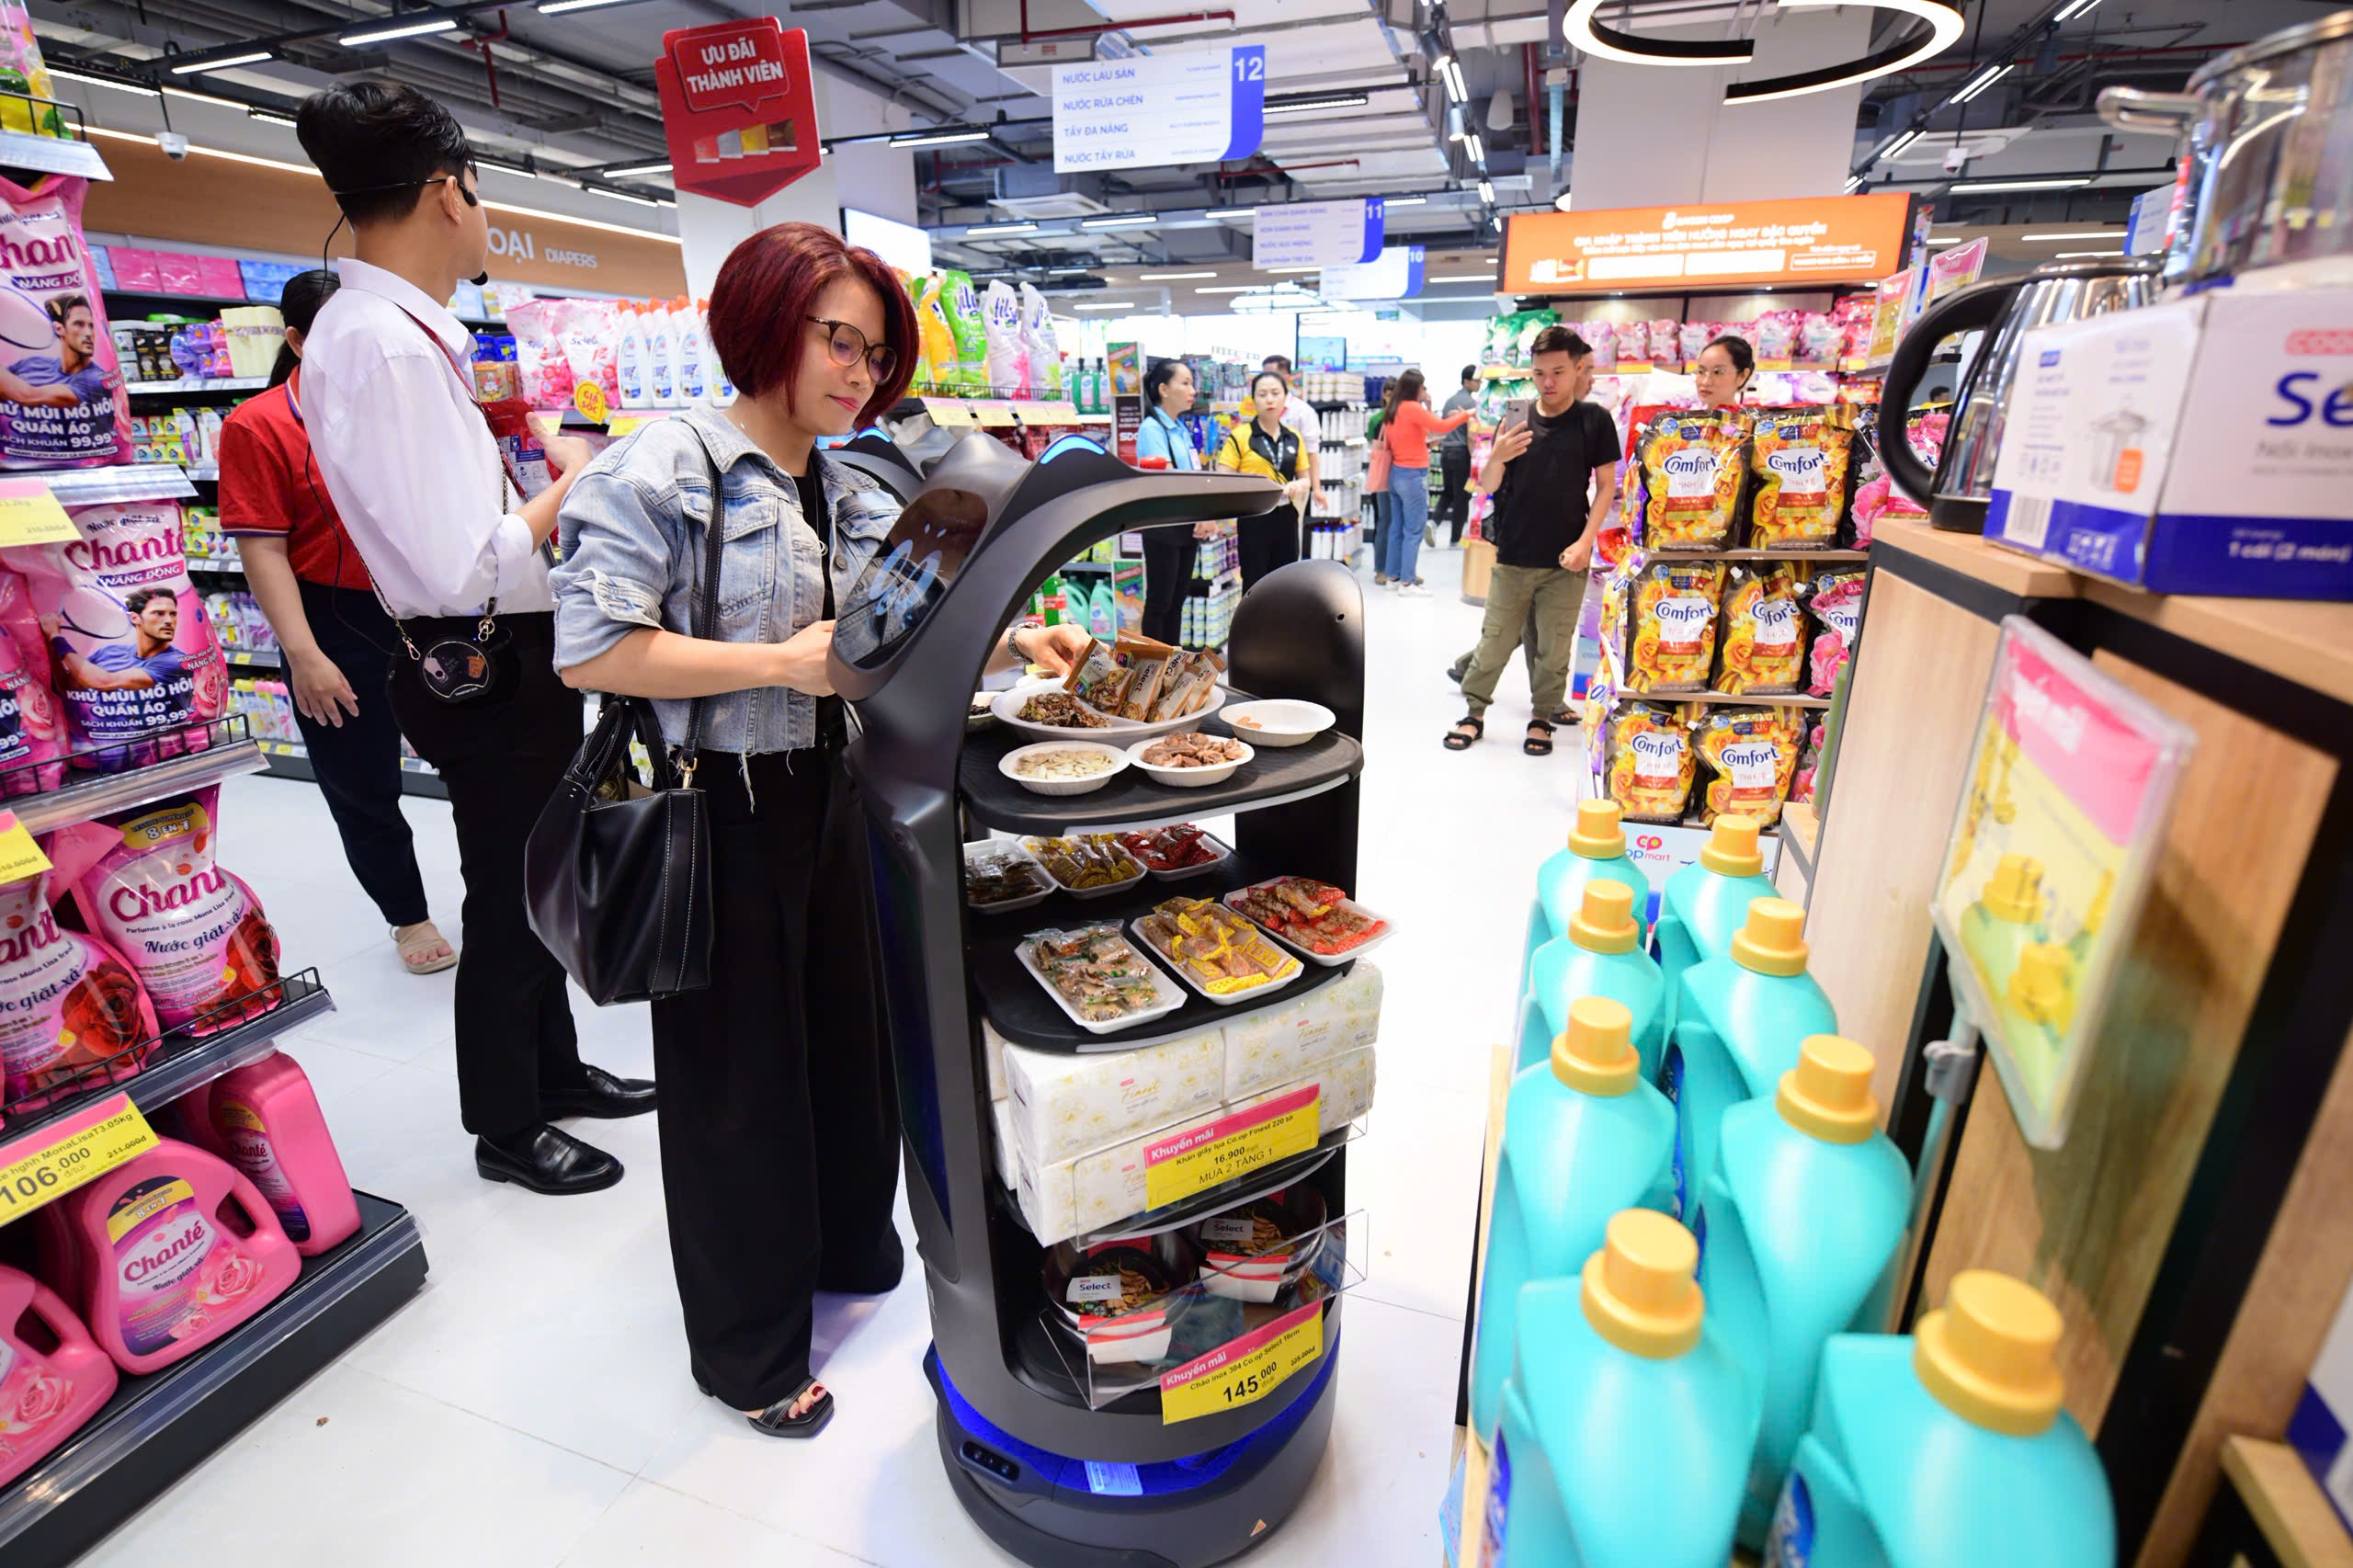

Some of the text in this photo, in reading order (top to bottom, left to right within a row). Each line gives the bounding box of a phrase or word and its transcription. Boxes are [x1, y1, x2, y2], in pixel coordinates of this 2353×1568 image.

[729, 37, 756, 60] ĐÃI
[687, 59, 784, 93] THÀNH VIÊN
[1234, 56, 1264, 82] 12
[1366, 204, 1382, 220] 11
[0, 233, 76, 270] han
[487, 227, 597, 268] OẠI DIAPERS
[1410, 250, 1424, 263] 10
[23, 404, 61, 420] MÙI
[1664, 454, 1717, 475] Comfort
[1768, 451, 1829, 475] Comfort
[146, 565, 181, 580] ĐỘNG
[1655, 601, 1715, 623] Comfort
[66, 688, 98, 702] KHỬ
[101, 688, 136, 702] MÙI
[168, 677, 194, 696] HÔI
[92, 701, 140, 718] QUẦN
[1632, 734, 1685, 757] Comfort
[1721, 744, 1780, 767] Comfort
[146, 826, 161, 840] 8
[161, 824, 177, 834] EN
[1644, 853, 1670, 861] mart
[109, 859, 227, 923] Chant
[194, 910, 213, 920] Mona
[144, 936, 189, 955] Nước
[1249, 1123, 1271, 1137] Finest
[1272, 1117, 1285, 1128] 220
[1151, 1127, 1214, 1161] Khuyến mãi
[1199, 1167, 1223, 1185] MUA
[1225, 1164, 1233, 1174] 2
[1267, 1147, 1274, 1156] 1
[1214, 1146, 1245, 1165] 16.900
[1213, 1223, 1245, 1233] Select
[123, 1220, 206, 1282] Chanté
[1079, 1282, 1112, 1291] Select
[1166, 1352, 1227, 1385] Khuyến mãi
[1211, 1370, 1228, 1382] inox
[1229, 1363, 1242, 1375] 304
[1264, 1339, 1283, 1357] Select
